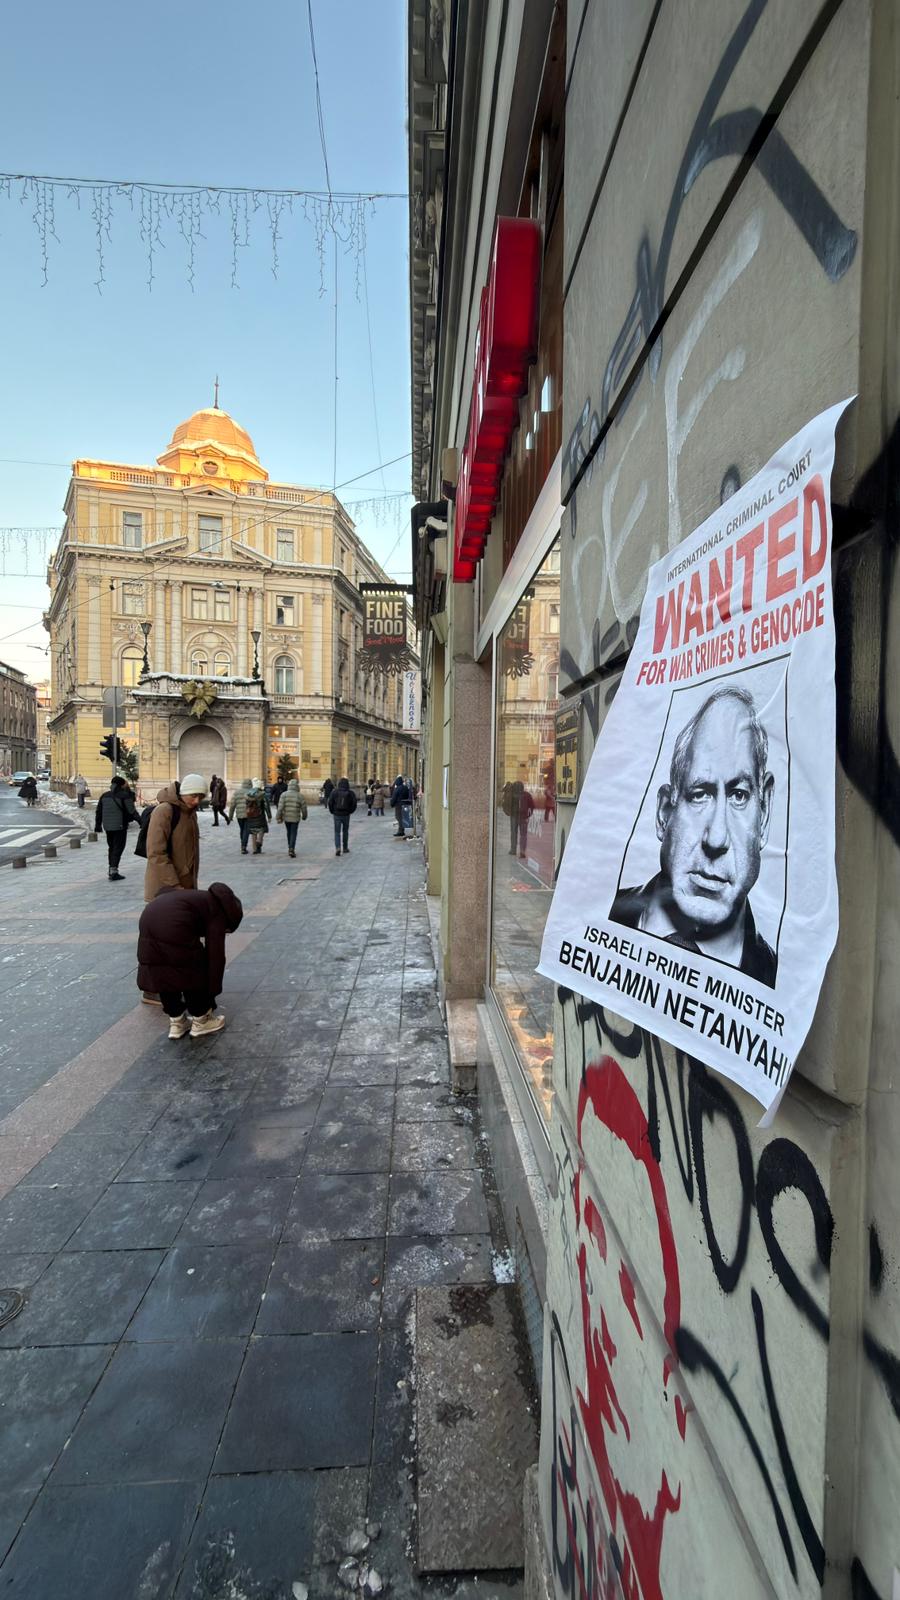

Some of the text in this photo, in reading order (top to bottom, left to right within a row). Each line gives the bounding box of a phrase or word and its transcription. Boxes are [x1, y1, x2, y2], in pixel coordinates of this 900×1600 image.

[653, 473, 828, 655] WANTED
[667, 448, 812, 583] INTERNATIONAL CRIMINAL COURT
[366, 601, 403, 619] FINE
[366, 619, 403, 635] FOOD
[636, 583, 825, 686] FOR WAR CRIMES & GENOCIDE
[559, 940, 660, 1008] BENJAMIN
[583, 925, 785, 1037] ISRAELI PRIME MINISTER
